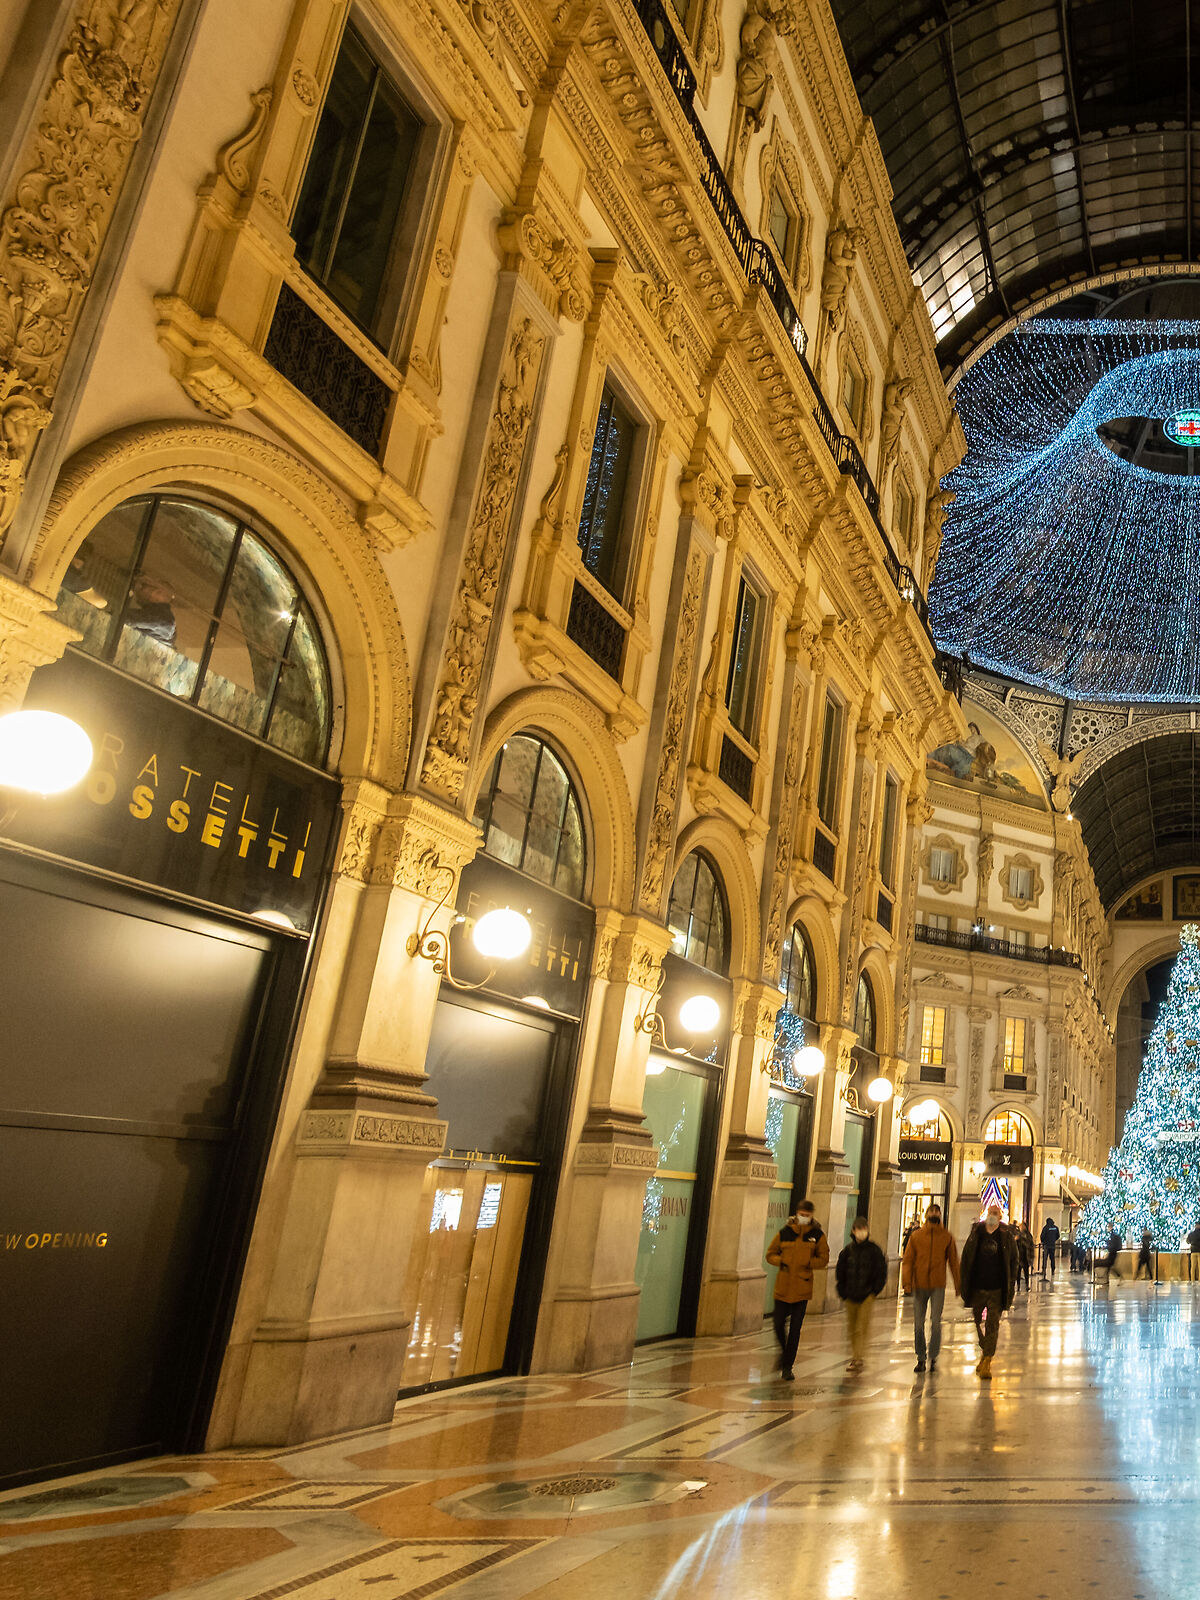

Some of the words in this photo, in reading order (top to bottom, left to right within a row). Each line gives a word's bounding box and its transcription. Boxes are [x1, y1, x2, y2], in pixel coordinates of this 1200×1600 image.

[102, 732, 312, 848] RATELLI
[87, 770, 305, 878] OSSETTI
[462, 915, 579, 981] RETTI
[466, 891, 582, 959] FELLI
[898, 1152, 918, 1160] LOUIS
[919, 1152, 947, 1162] VUITTON
[25, 1232, 108, 1249] OPENING
